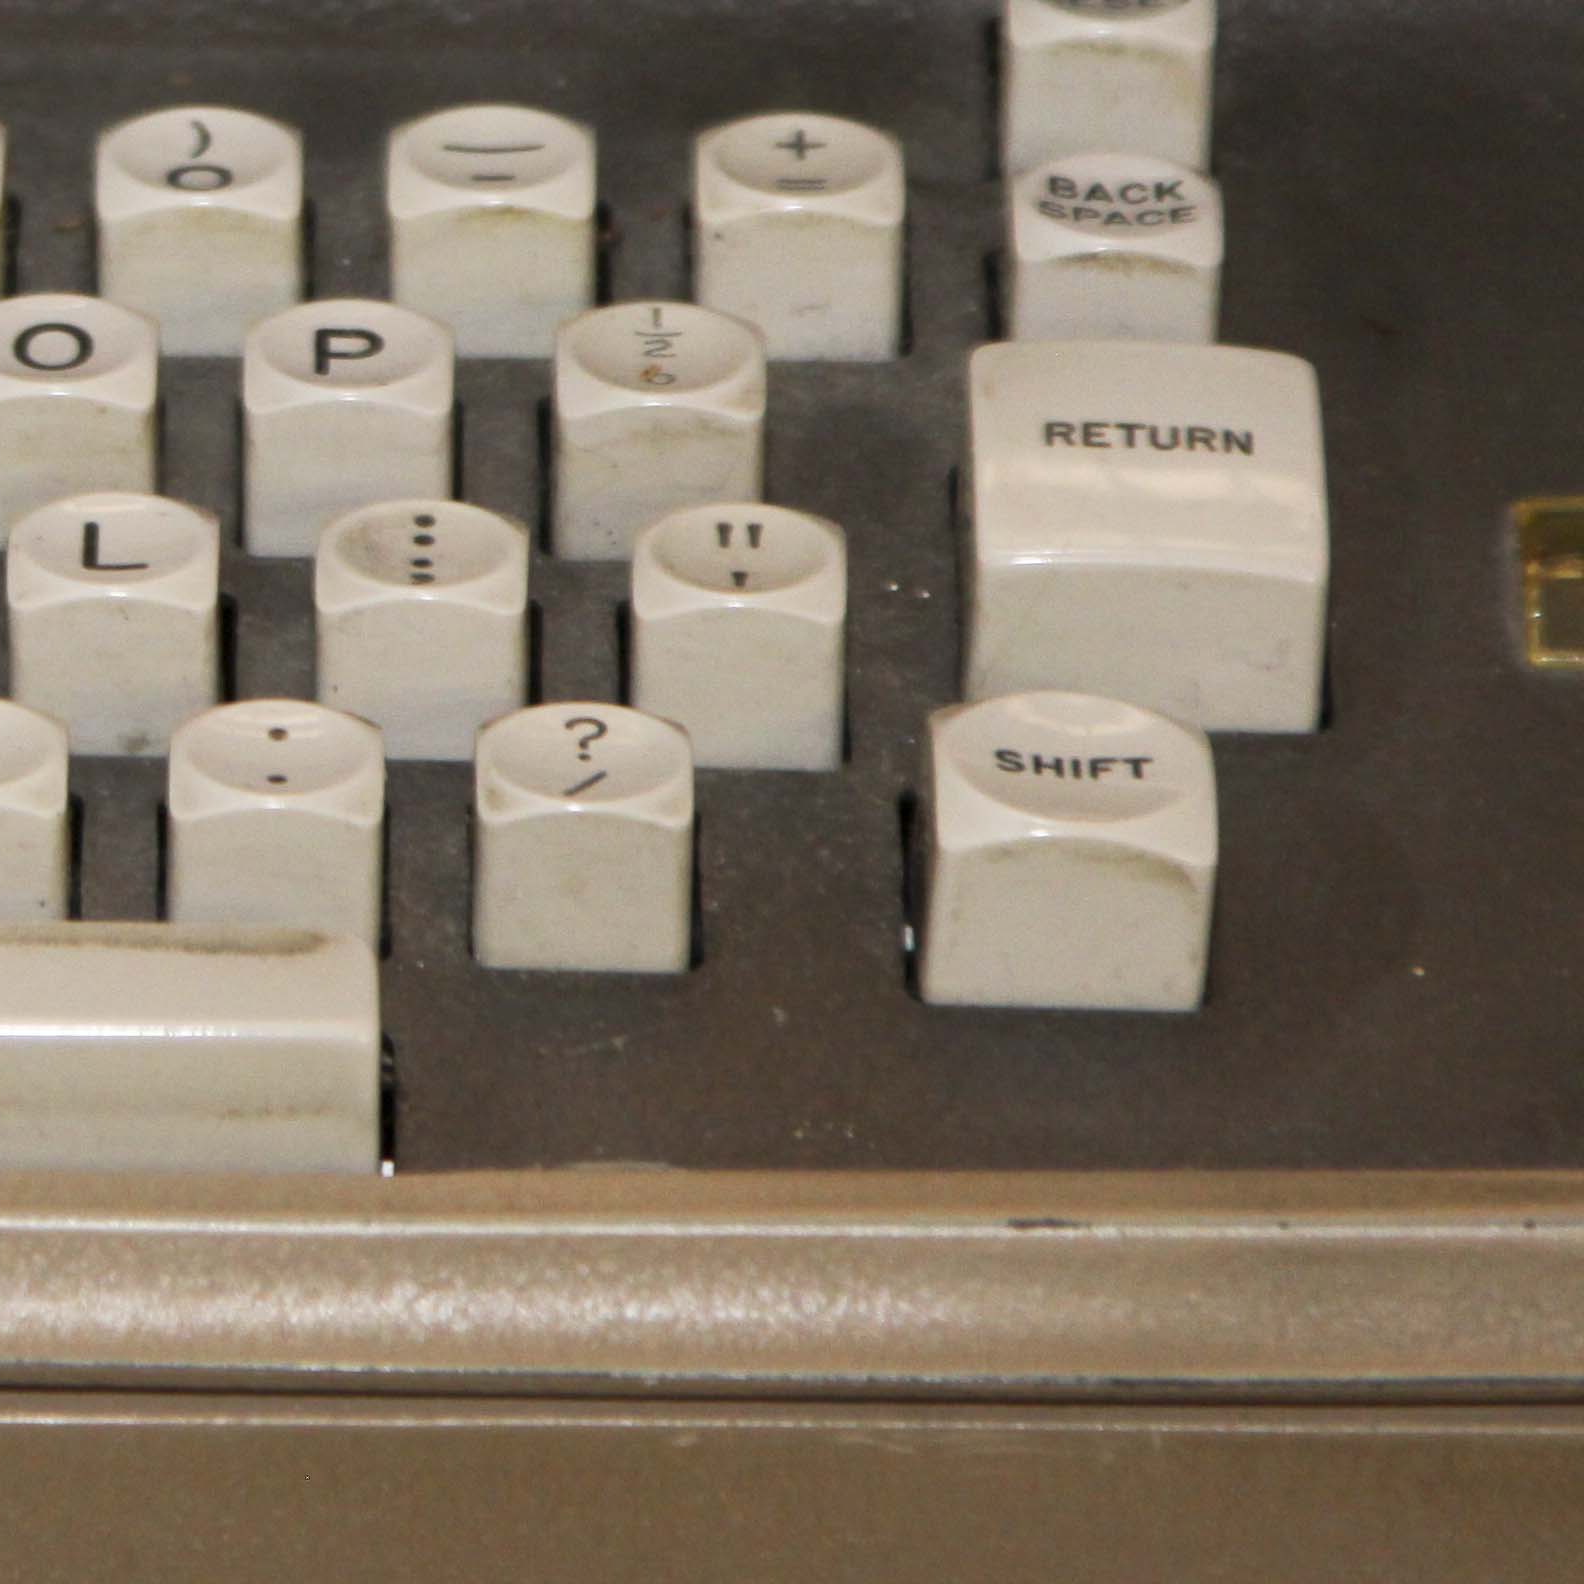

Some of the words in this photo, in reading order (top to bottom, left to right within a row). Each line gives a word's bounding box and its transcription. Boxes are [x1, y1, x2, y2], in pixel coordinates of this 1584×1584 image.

[1044, 174, 1185, 204] BACK
[1036, 198, 1195, 227] SPACE
[11, 322, 94, 373] O
[313, 328, 384, 377] P
[1042, 421, 1254, 457] RETURN
[80, 522, 149, 572] L
[564, 717, 608, 763] ?
[994, 749, 1153, 781] SHIFT
